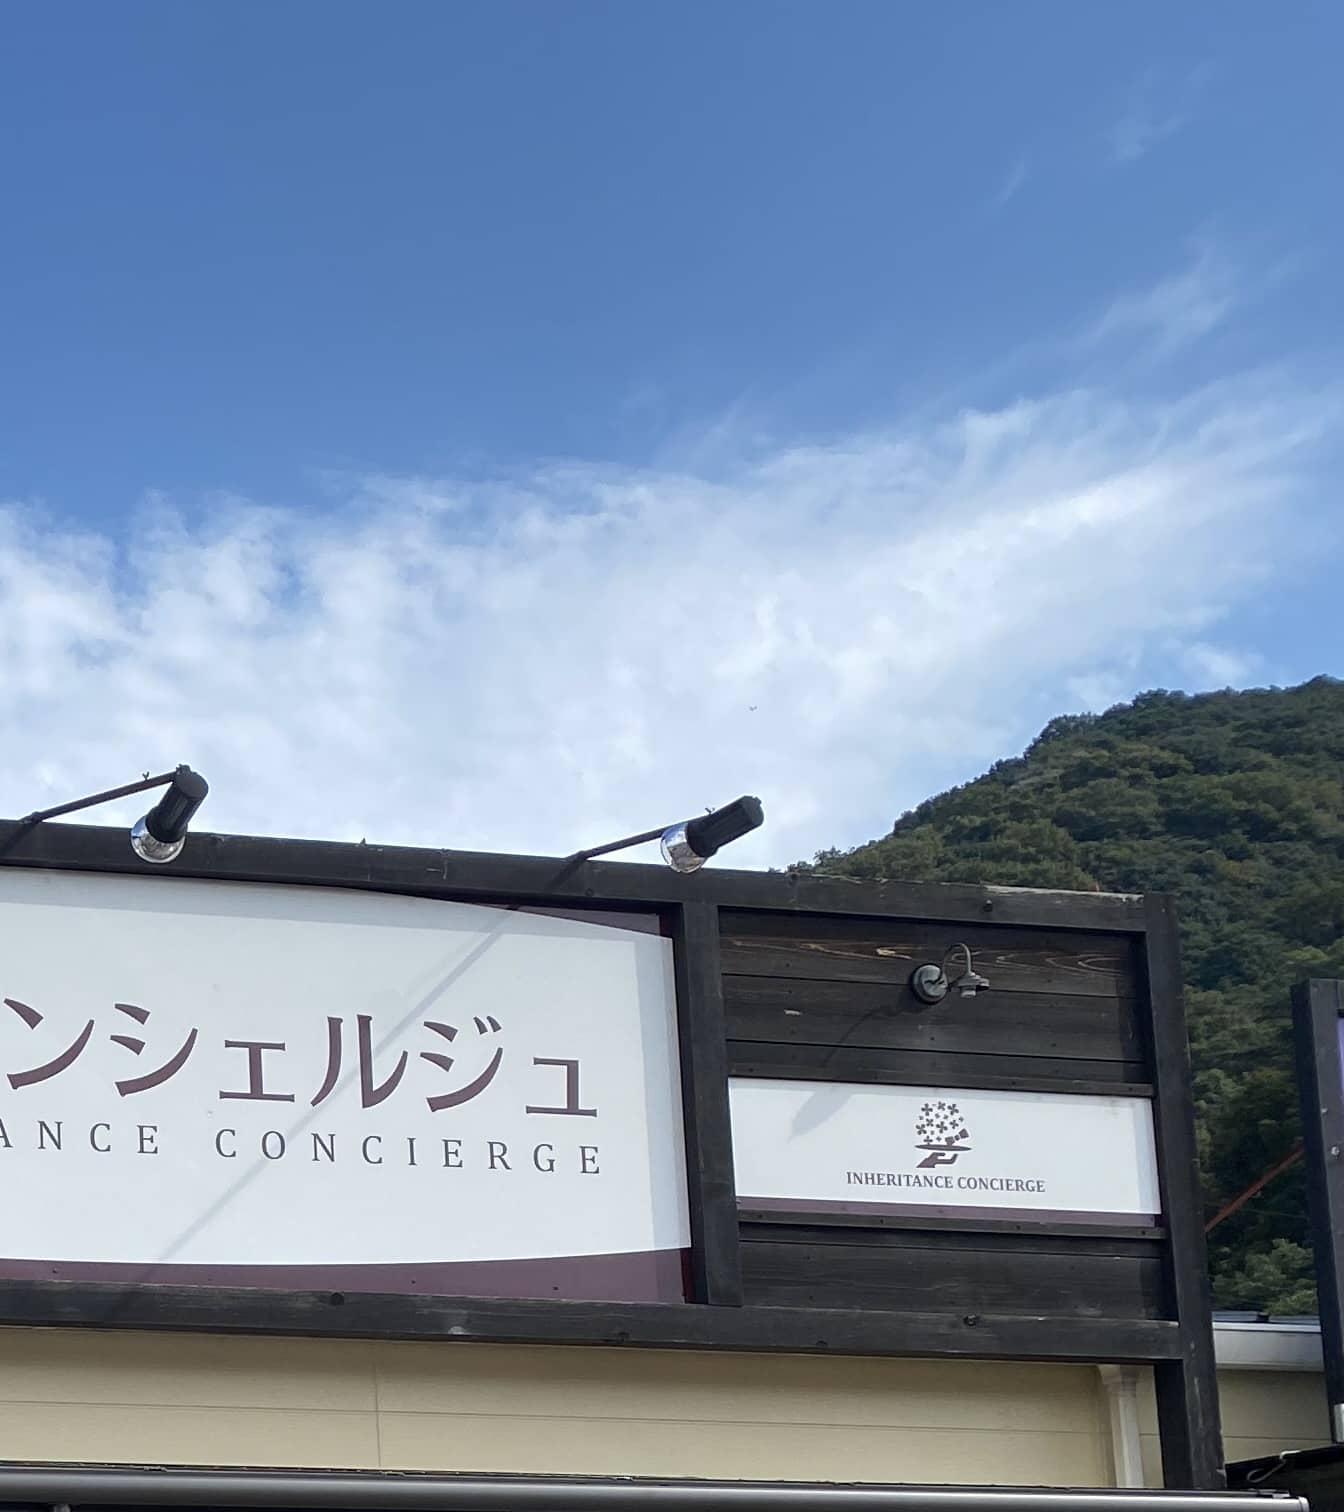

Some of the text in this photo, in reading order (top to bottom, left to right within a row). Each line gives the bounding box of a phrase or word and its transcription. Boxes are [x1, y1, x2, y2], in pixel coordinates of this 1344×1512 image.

[215, 1128, 601, 1174] CONCIERGE
[846, 1171, 1045, 1193] INHERITANCE CONCIERGE
